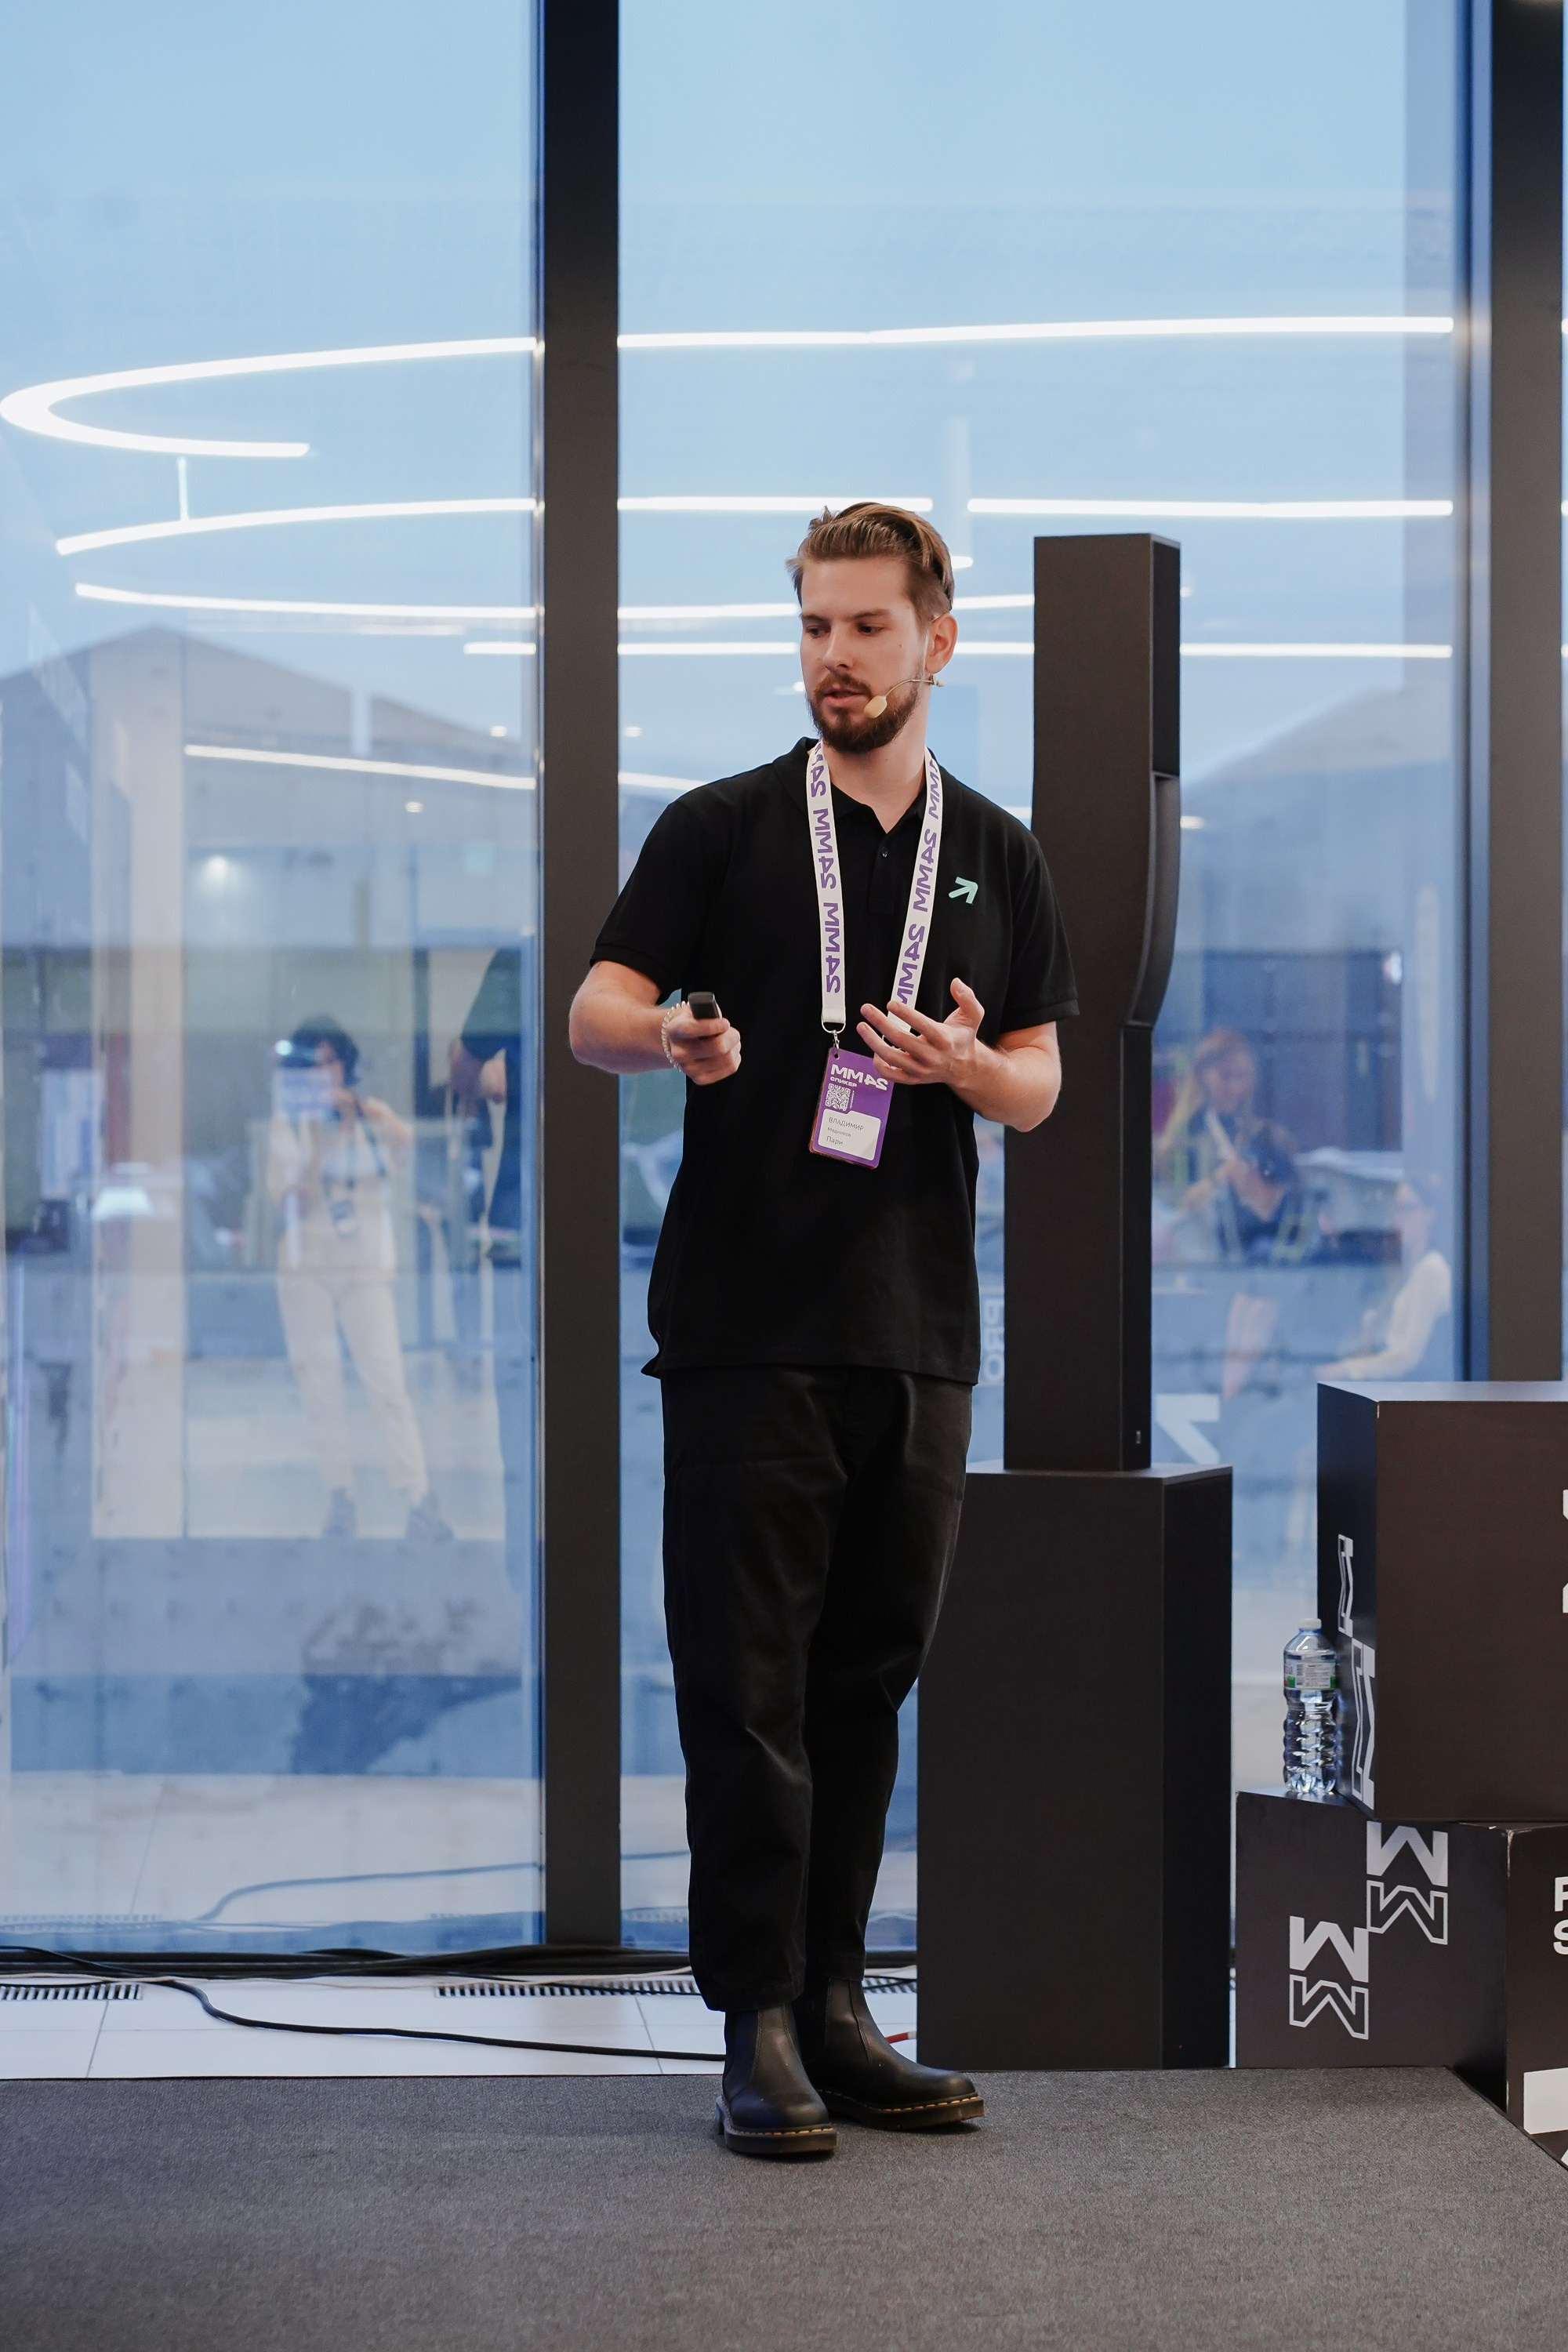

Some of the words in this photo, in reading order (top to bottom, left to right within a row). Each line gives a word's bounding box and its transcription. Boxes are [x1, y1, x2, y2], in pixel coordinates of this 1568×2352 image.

[829, 1076, 858, 1088] СПИКЕР
[829, 1116, 865, 1131] ВЛАДИМИР
[826, 1135, 843, 1145] Пари
